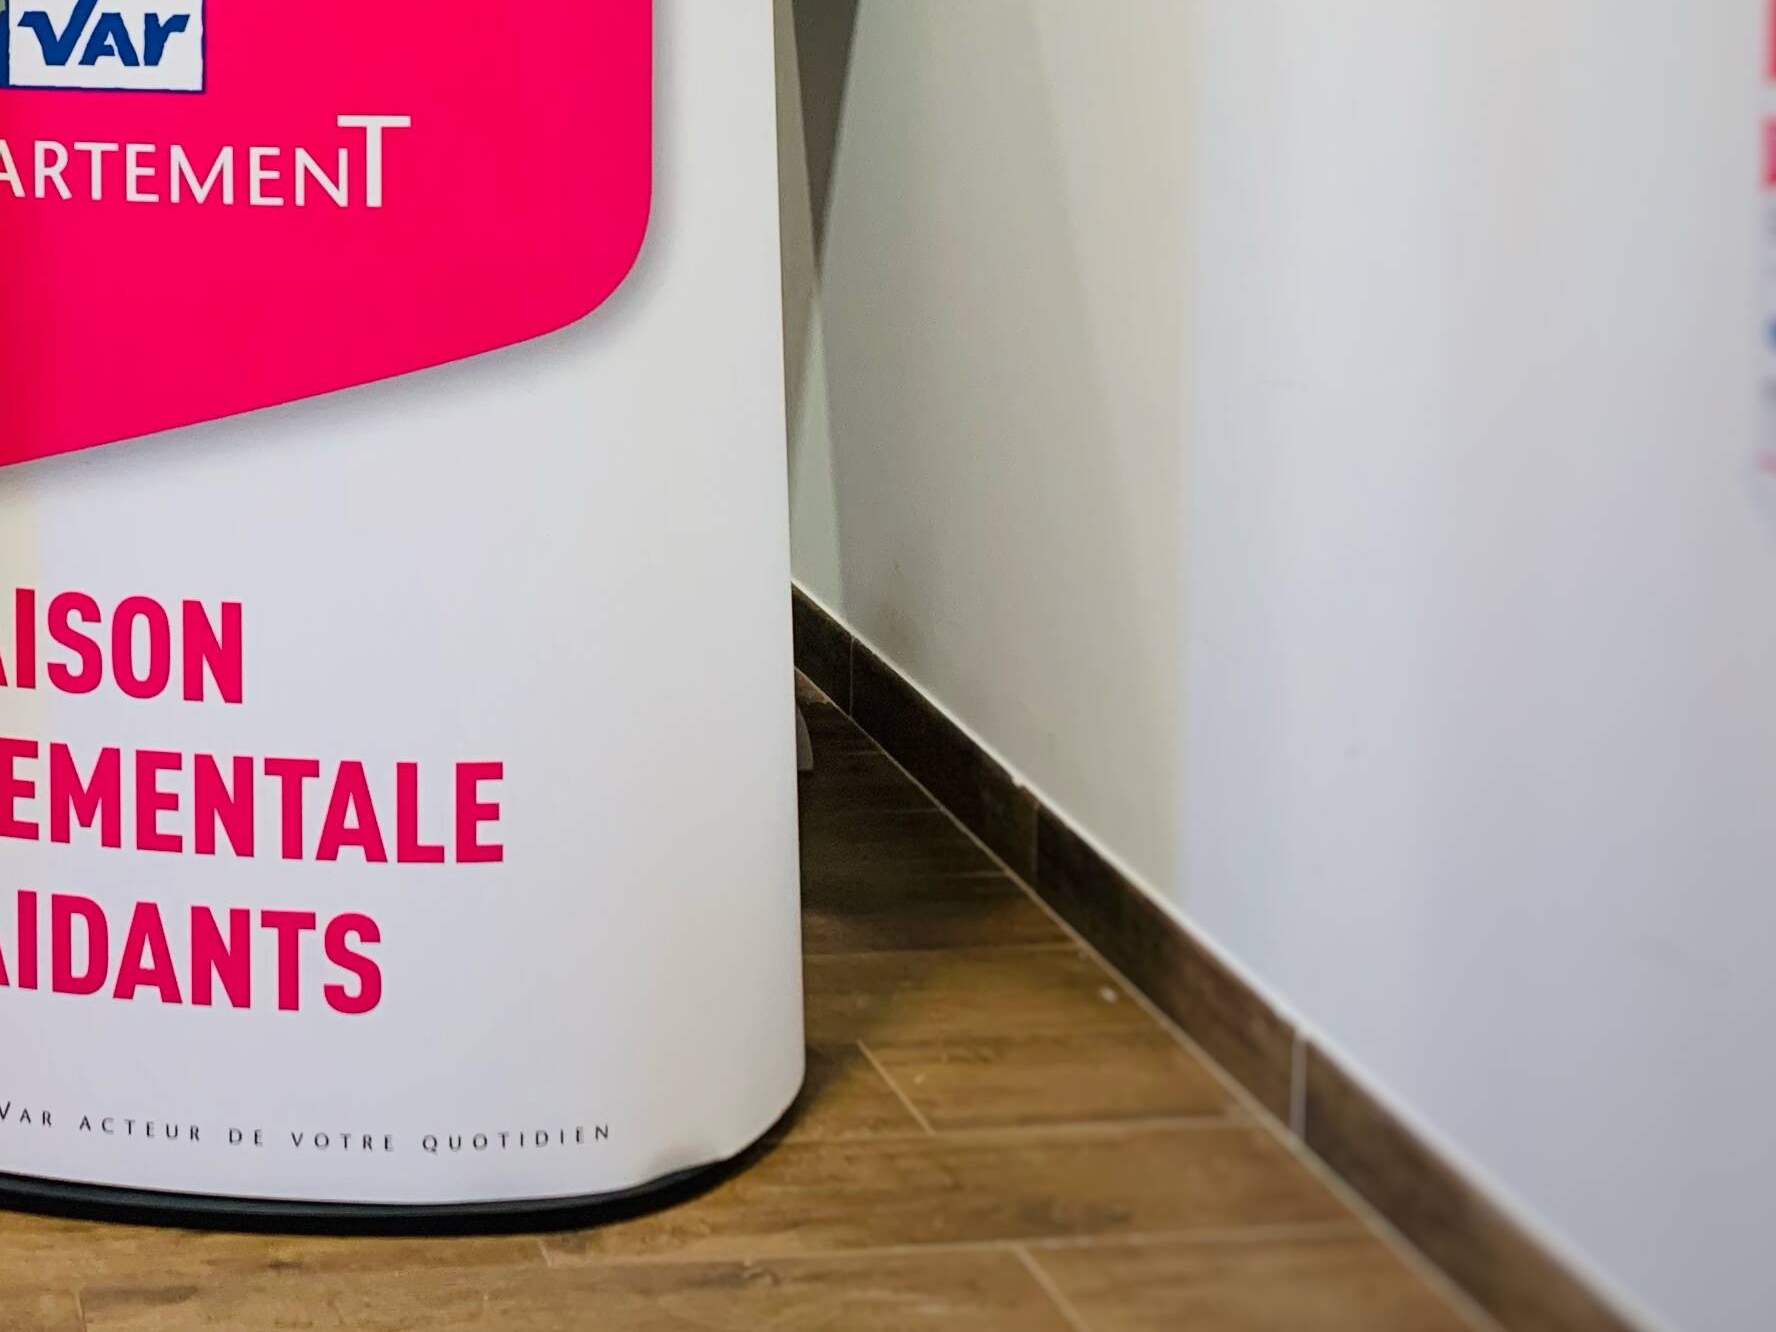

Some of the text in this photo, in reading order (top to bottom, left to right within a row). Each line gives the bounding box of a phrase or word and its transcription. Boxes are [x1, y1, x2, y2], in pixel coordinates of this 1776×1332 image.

[79, 1116, 201, 1142] ACTEUR
[228, 1127, 265, 1147] DE
[291, 1131, 395, 1153] VOTRE
[422, 1123, 610, 1156] QUOTIDIEN
